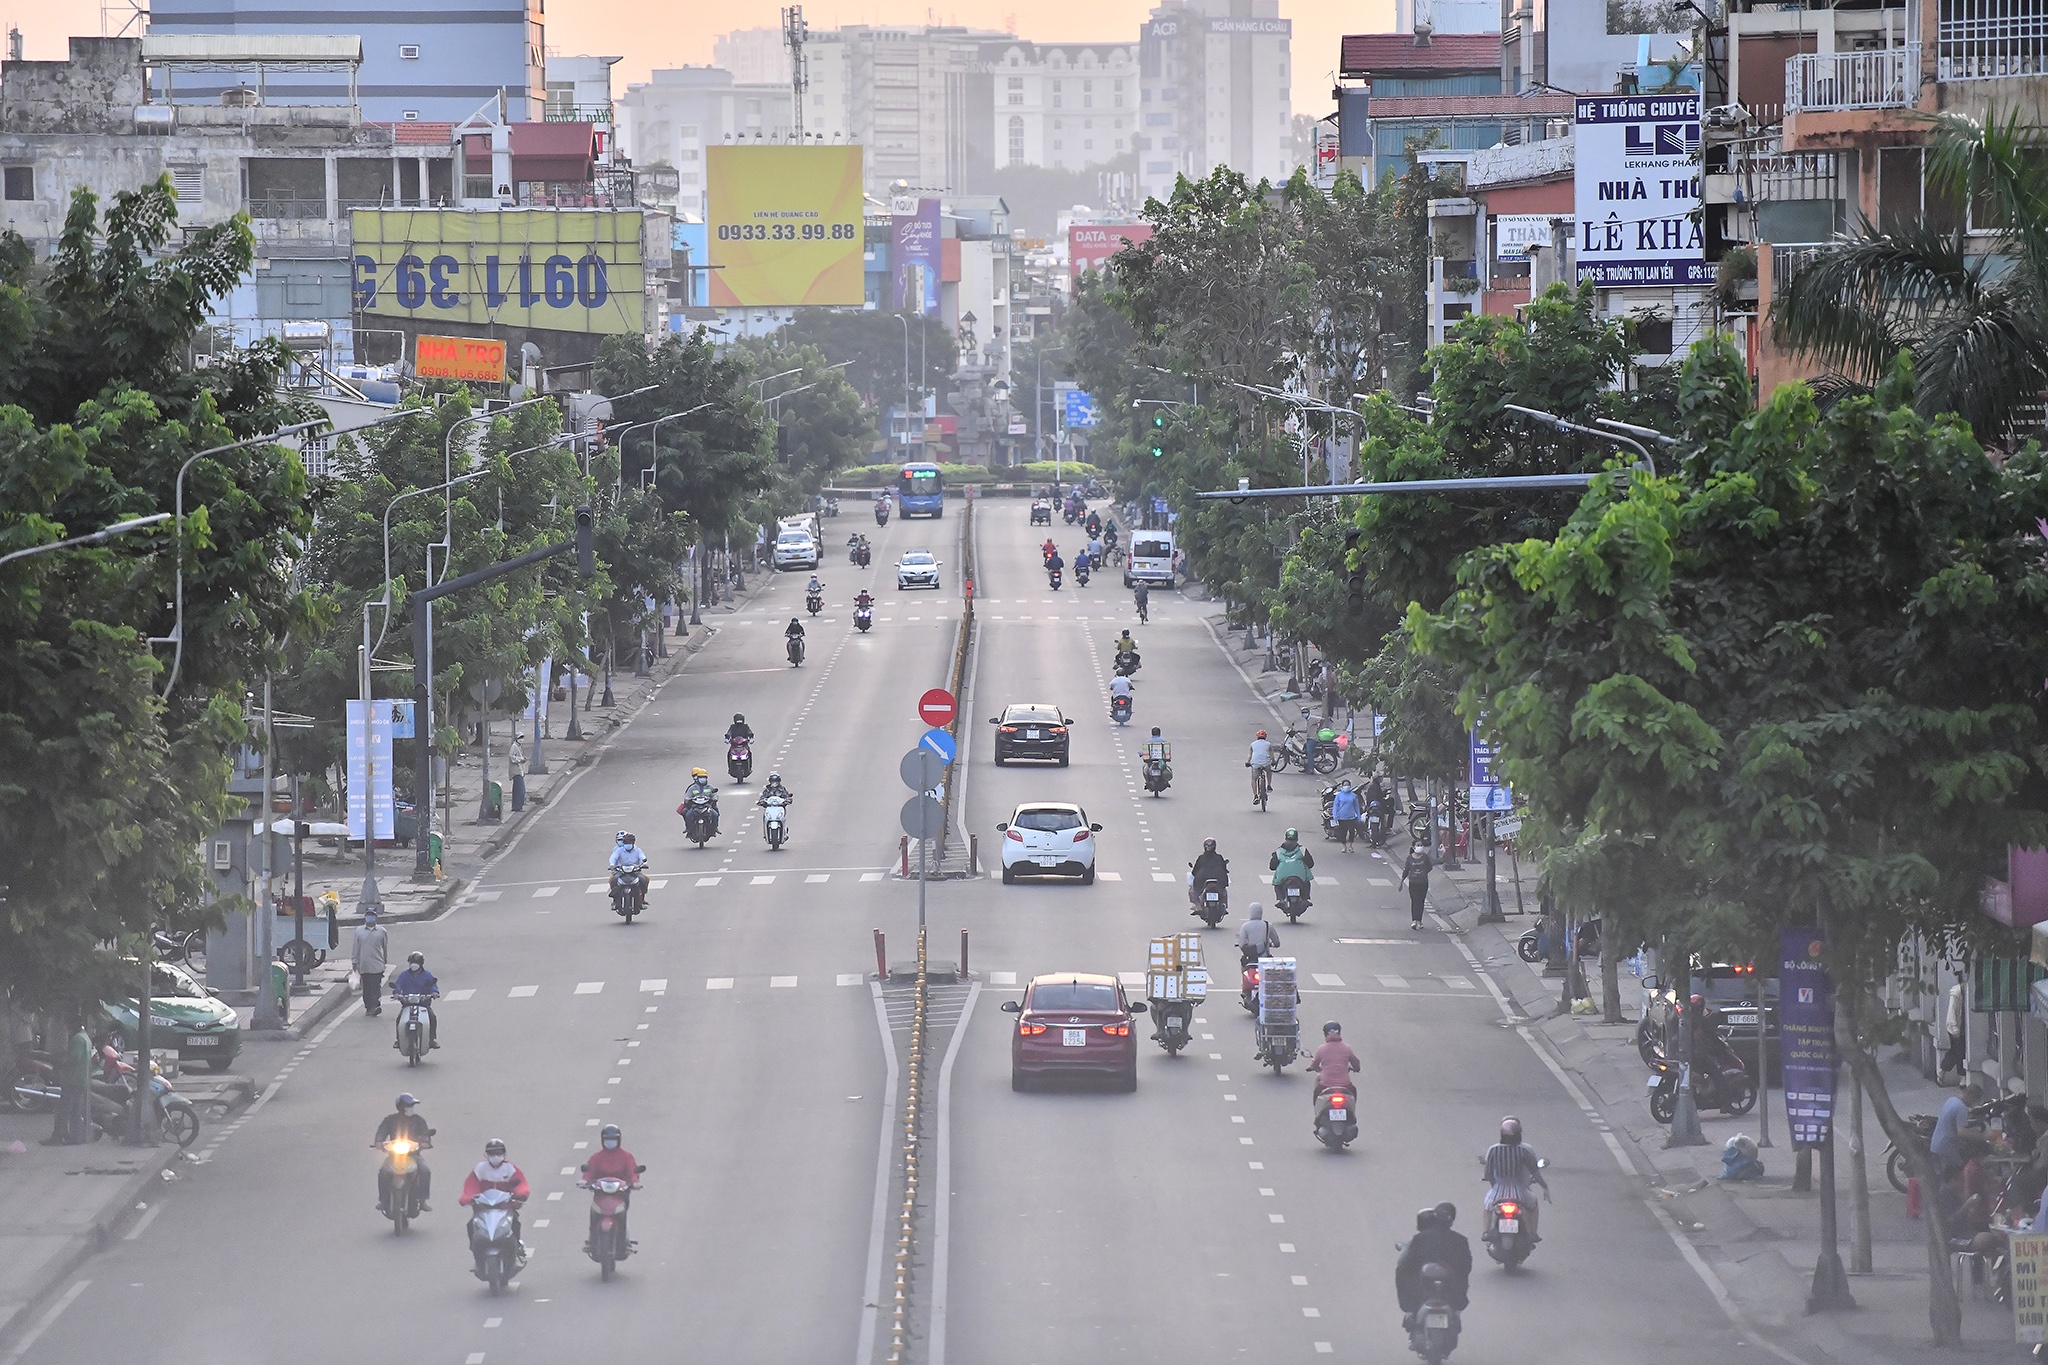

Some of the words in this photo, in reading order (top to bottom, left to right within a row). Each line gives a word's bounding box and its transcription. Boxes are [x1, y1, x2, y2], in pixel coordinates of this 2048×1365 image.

[1152, 22, 1177, 36] ACB
[1578, 101, 1596, 121] HỆ
[1601, 99, 1646, 118] THỐNG
[1650, 98, 1700, 117] CHUYÊ
[1625, 160, 1669, 169] LEKHANG
[1598, 176, 1648, 201] NHÀ
[894, 200, 915, 212] AQUA
[717, 223, 855, 241] 0933.33.99.88
[1075, 230, 1107, 242] DATA
[1581, 211, 1623, 252] LÊ
[1633, 266, 1645, 284] THỊ
[1645, 266, 1659, 280] LAN
[418, 338, 458, 362] NHÀ
[464, 343, 503, 369] TRỌ
[420, 365, 498, 380] 0908.166.686
[1784, 959, 1796, 972] BỘ
[1068, 1030, 1080, 1038] 86A
